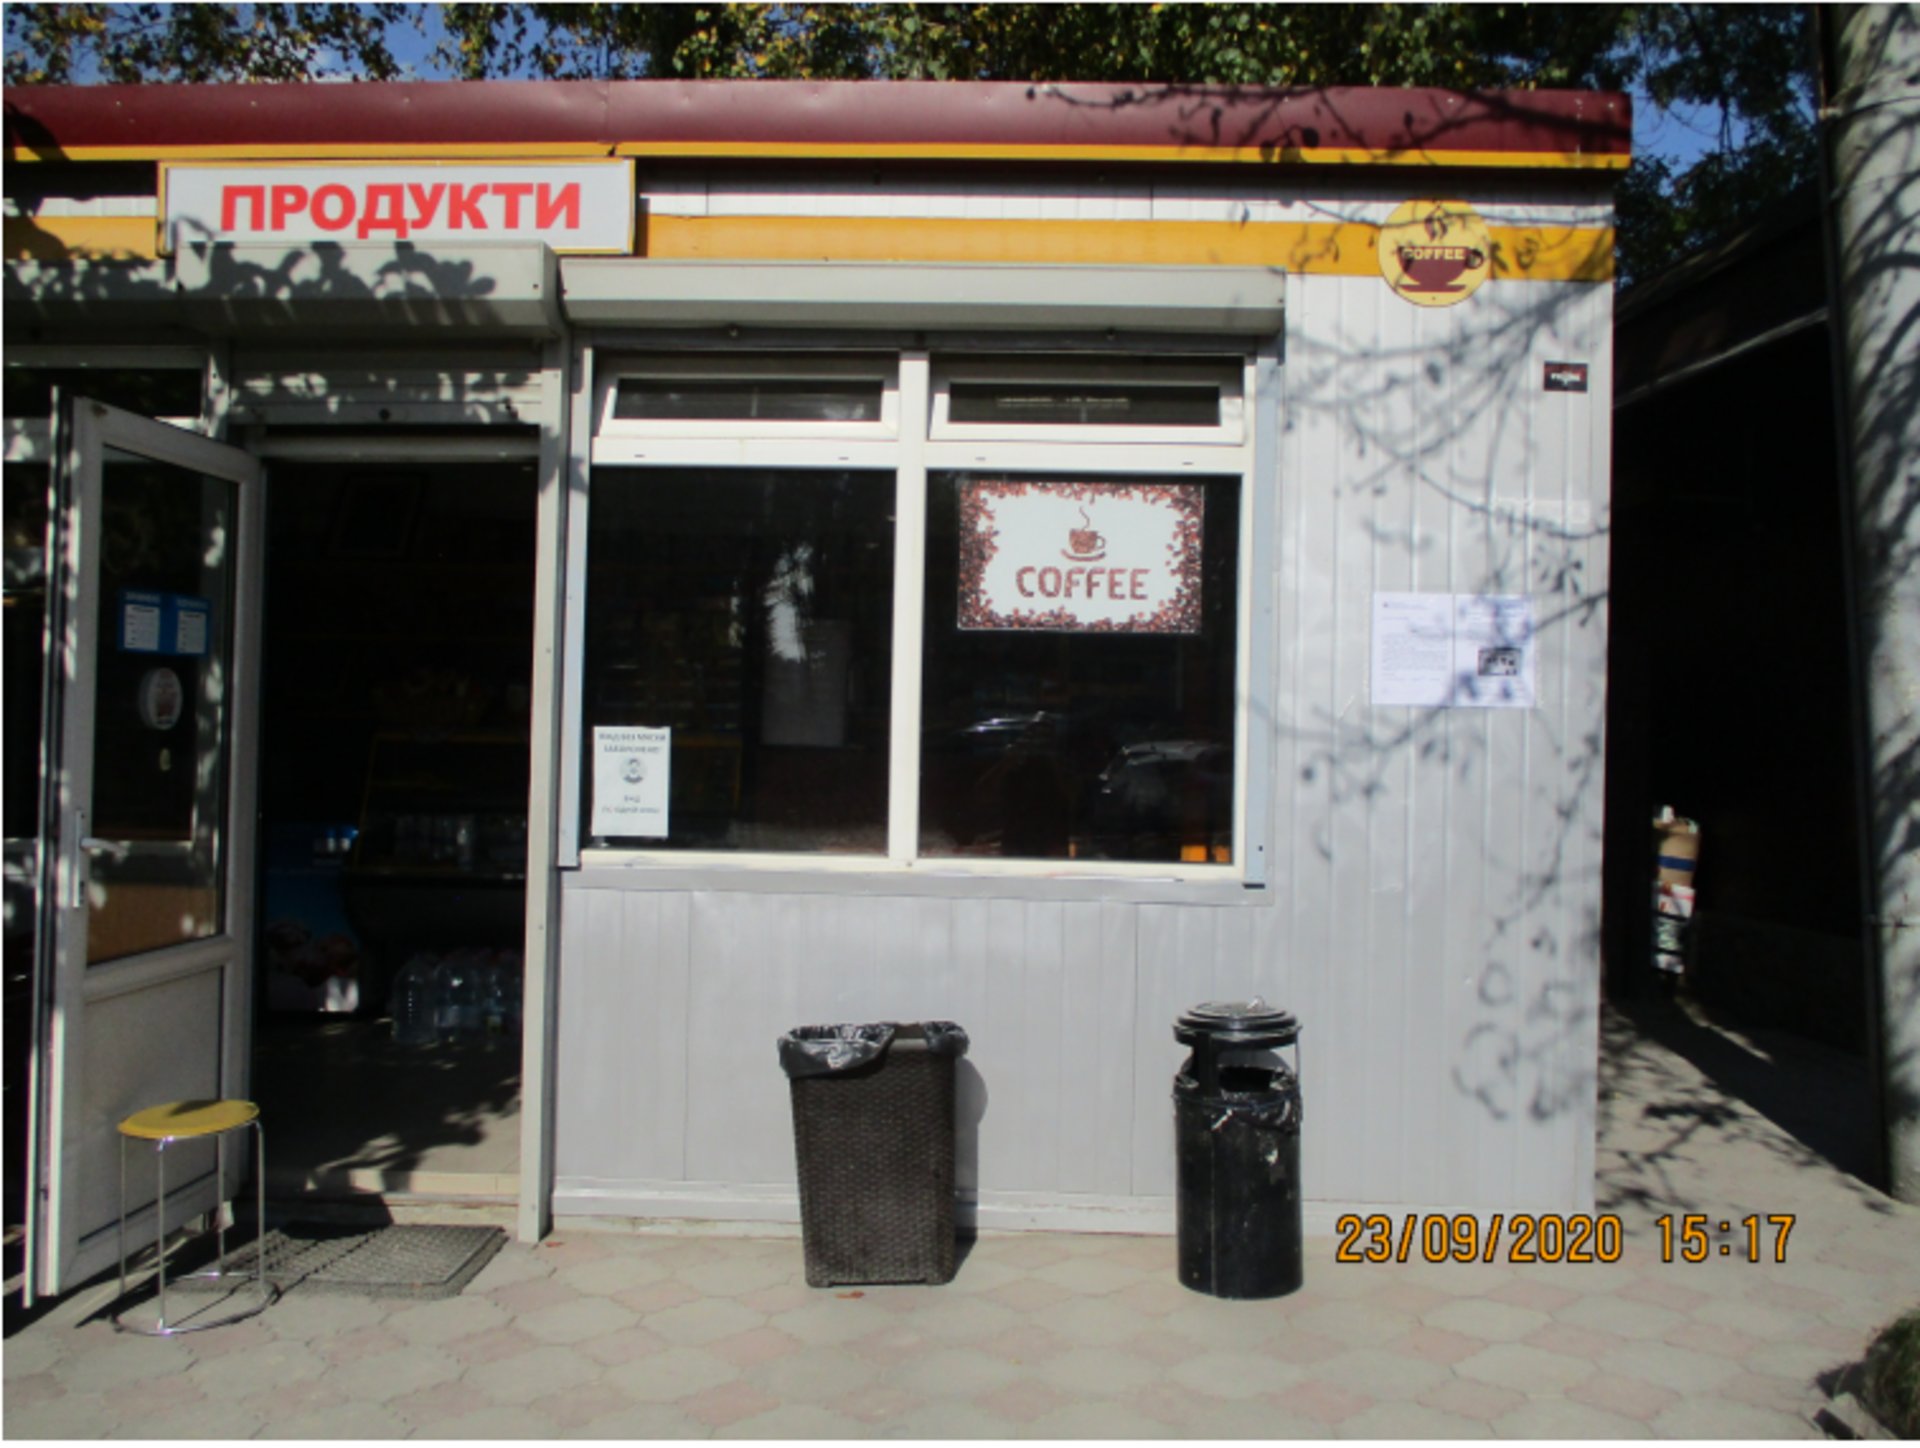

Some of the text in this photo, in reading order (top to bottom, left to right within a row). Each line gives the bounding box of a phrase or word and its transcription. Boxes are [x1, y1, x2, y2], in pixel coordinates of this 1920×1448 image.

[220, 182, 581, 239] ПРОДУКТИ
[1402, 248, 1465, 260] COFFEE
[1016, 565, 1151, 600] COFFEE
